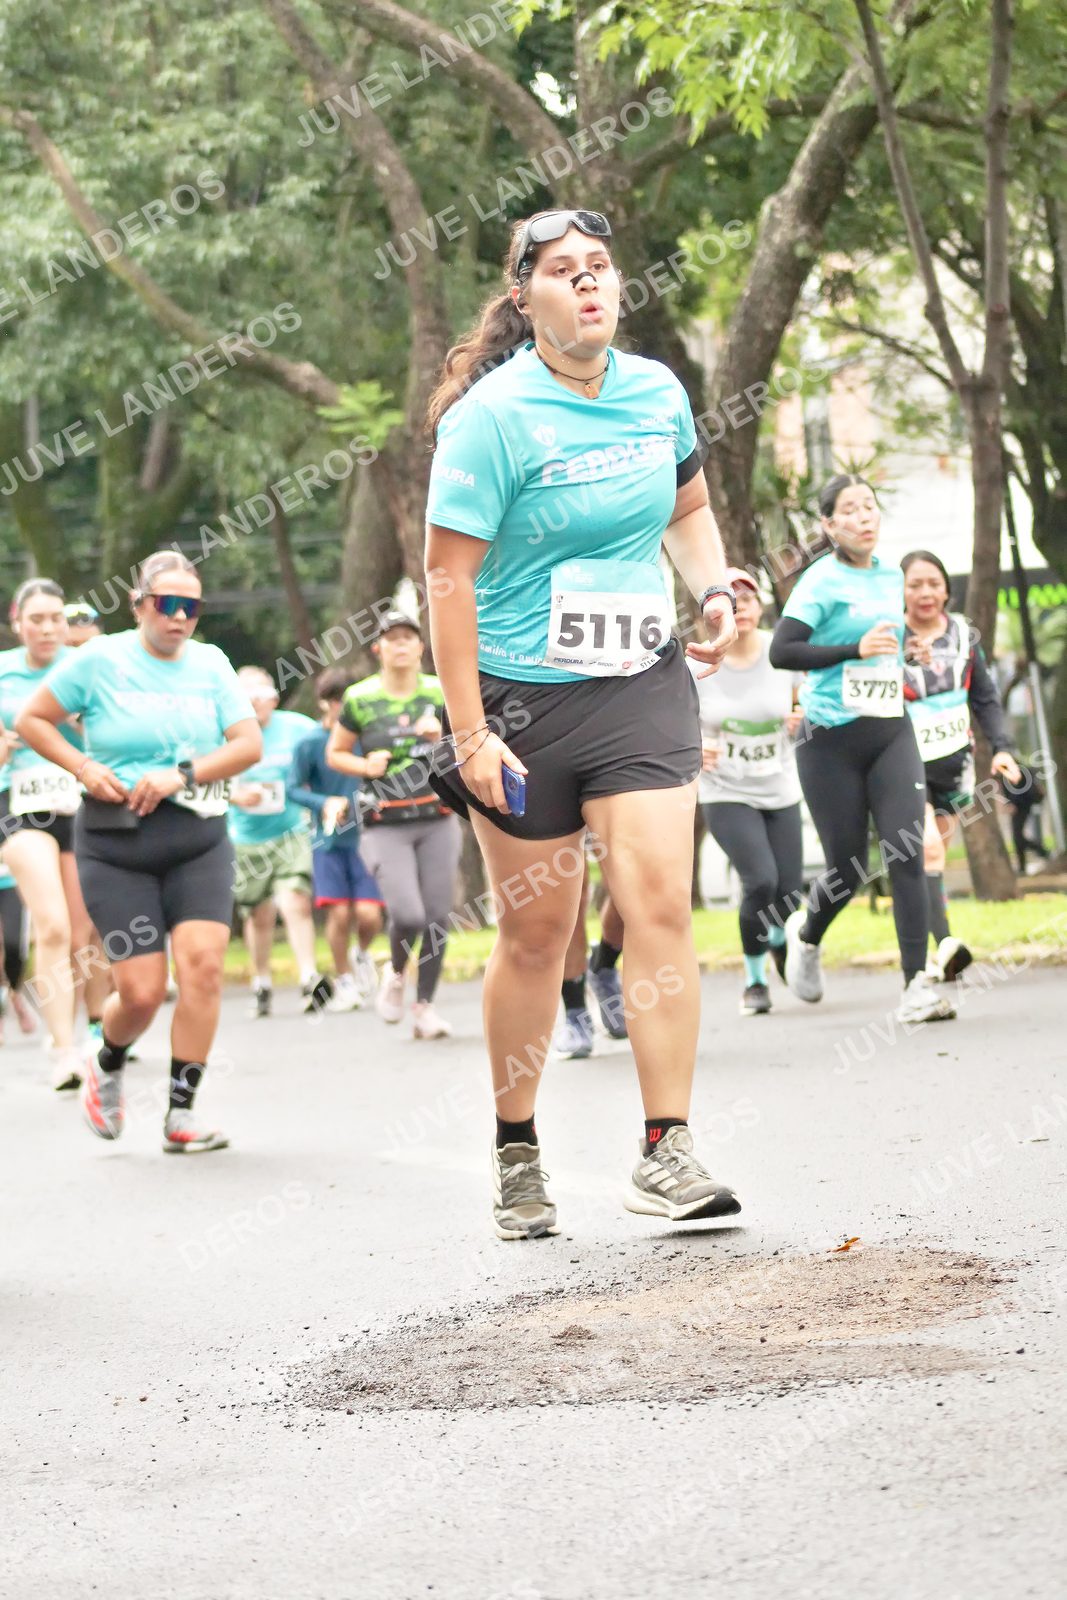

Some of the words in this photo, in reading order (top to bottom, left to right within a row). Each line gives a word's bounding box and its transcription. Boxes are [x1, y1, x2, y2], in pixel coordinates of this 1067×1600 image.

[557, 612, 662, 651] 5116
[849, 679, 898, 698] 3779
[919, 718, 966, 744] 2530
